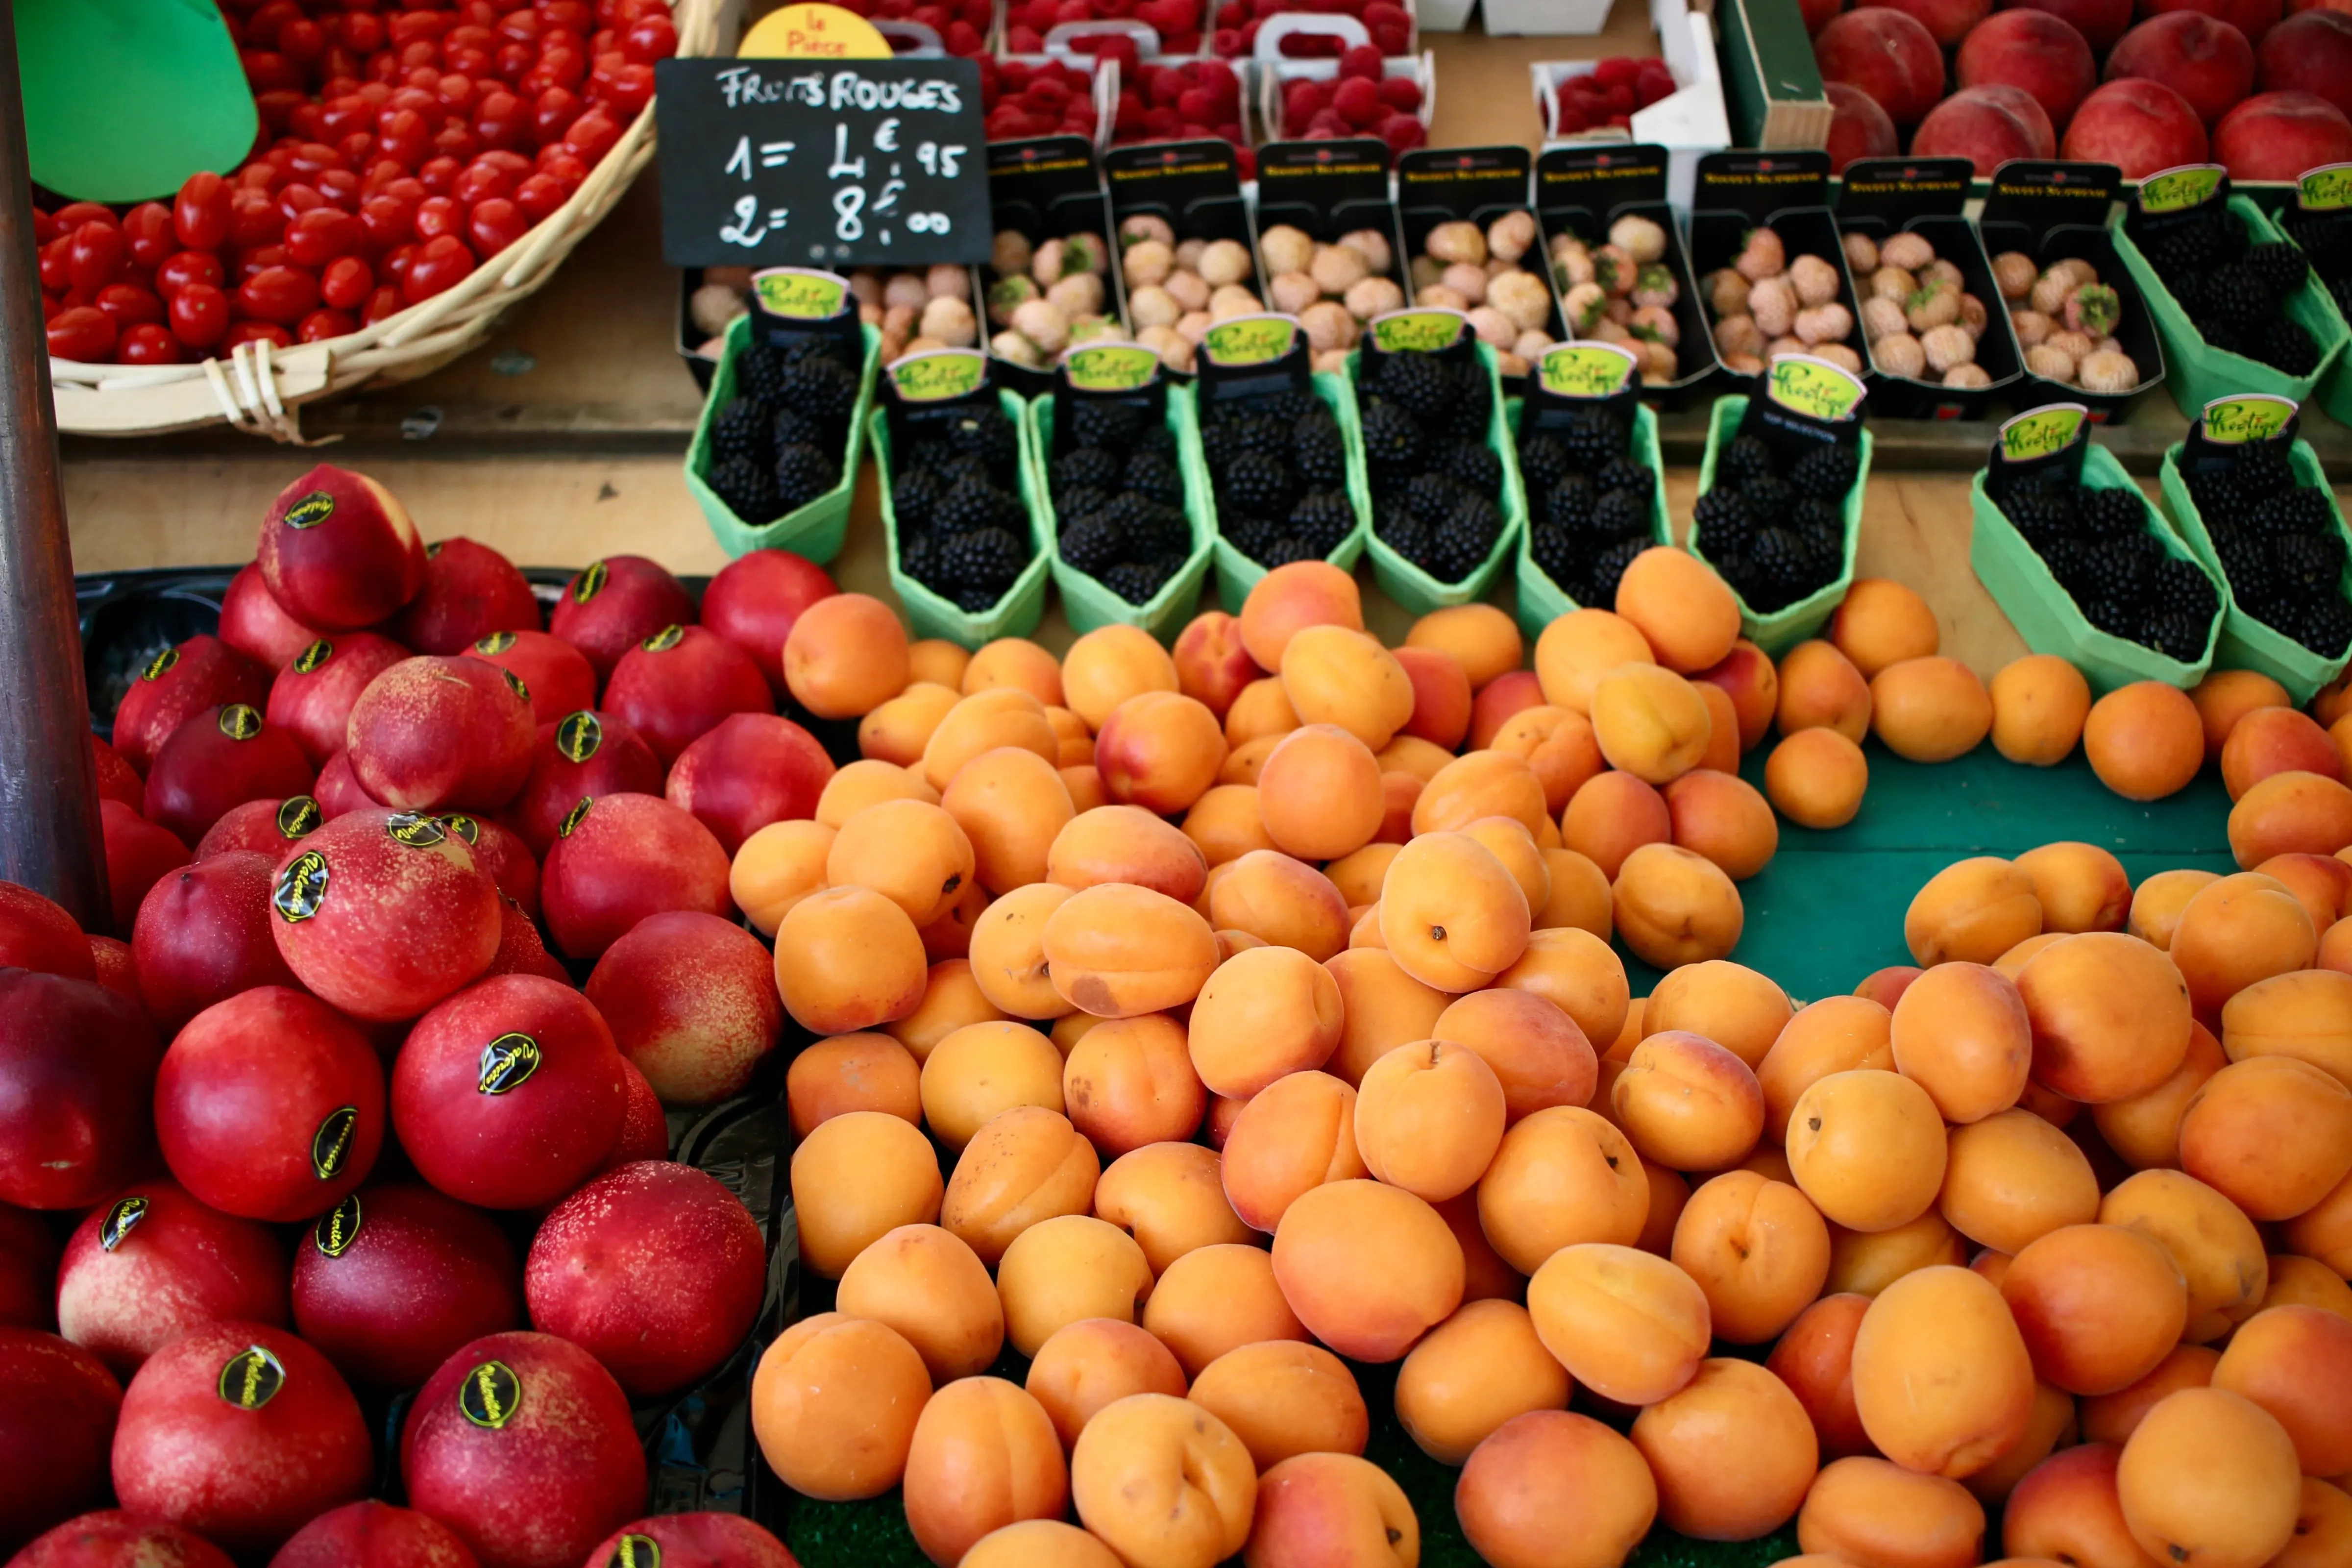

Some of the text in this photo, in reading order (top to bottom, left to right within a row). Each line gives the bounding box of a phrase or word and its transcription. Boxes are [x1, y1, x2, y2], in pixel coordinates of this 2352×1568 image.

[714, 66, 963, 114] FRUITS ROUGES
[485, 1043, 535, 1084] Valenita
